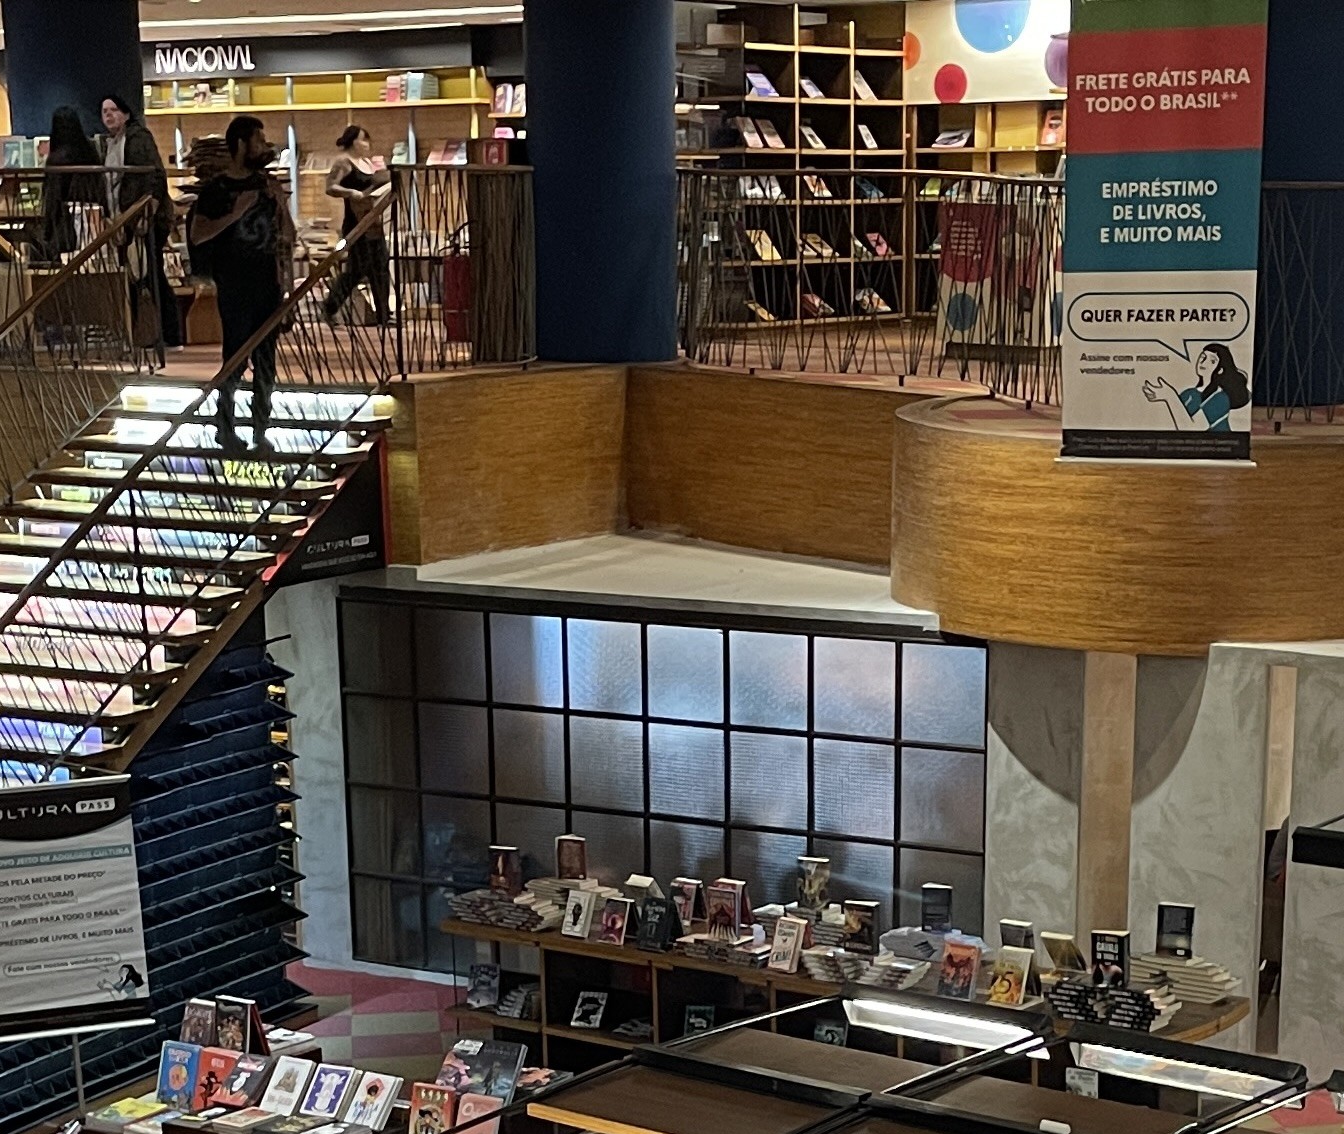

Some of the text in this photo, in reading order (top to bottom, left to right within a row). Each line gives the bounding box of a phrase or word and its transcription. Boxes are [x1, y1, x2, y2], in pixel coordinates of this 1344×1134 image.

[155, 44, 256, 74] NACIONAL
[1076, 66, 1251, 91] FRETE GRÁTIS PARA
[1085, 95, 1138, 114] TODO
[1141, 94, 1156, 111] O
[1101, 177, 1218, 199] EMPRÉSTIMO
[1112, 202, 1207, 222] DE LIVROS,
[1100, 224, 1222, 243] E MUITO MAIS
[1081, 307, 1237, 325] QUER FAZER PARTE?
[80, 799, 111, 812] PASS
[11, 878, 30, 886] PELA
[64, 873, 76, 881] DO
